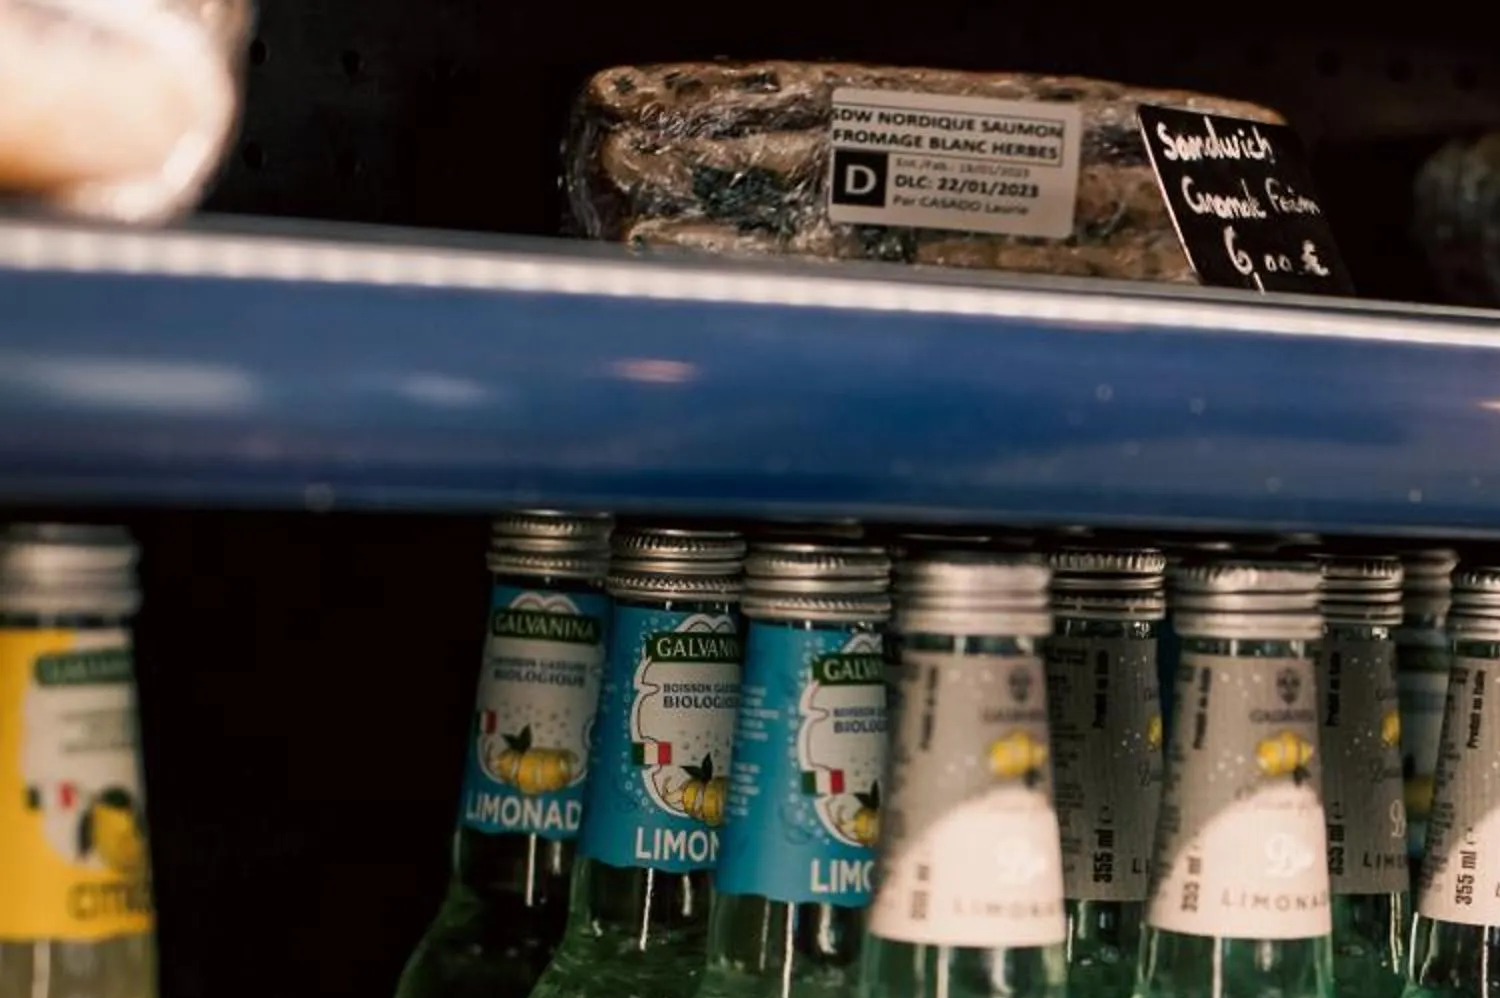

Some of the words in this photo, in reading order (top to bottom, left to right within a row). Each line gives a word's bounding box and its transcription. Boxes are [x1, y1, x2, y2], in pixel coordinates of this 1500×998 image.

[877, 111, 976, 132] NORDIQUE
[981, 120, 1064, 139] SAUMON
[1157, 116, 1274, 163] Sandwich
[832, 129, 924, 148] FROMAGE
[929, 137, 987, 155] BLANC
[991, 142, 1059, 160] HERBES
[845, 164, 878, 195] D
[937, 176, 1040, 198] 22/01/2023
[1459, 849, 1477, 870] ml
[1455, 873, 1475, 906] 355
